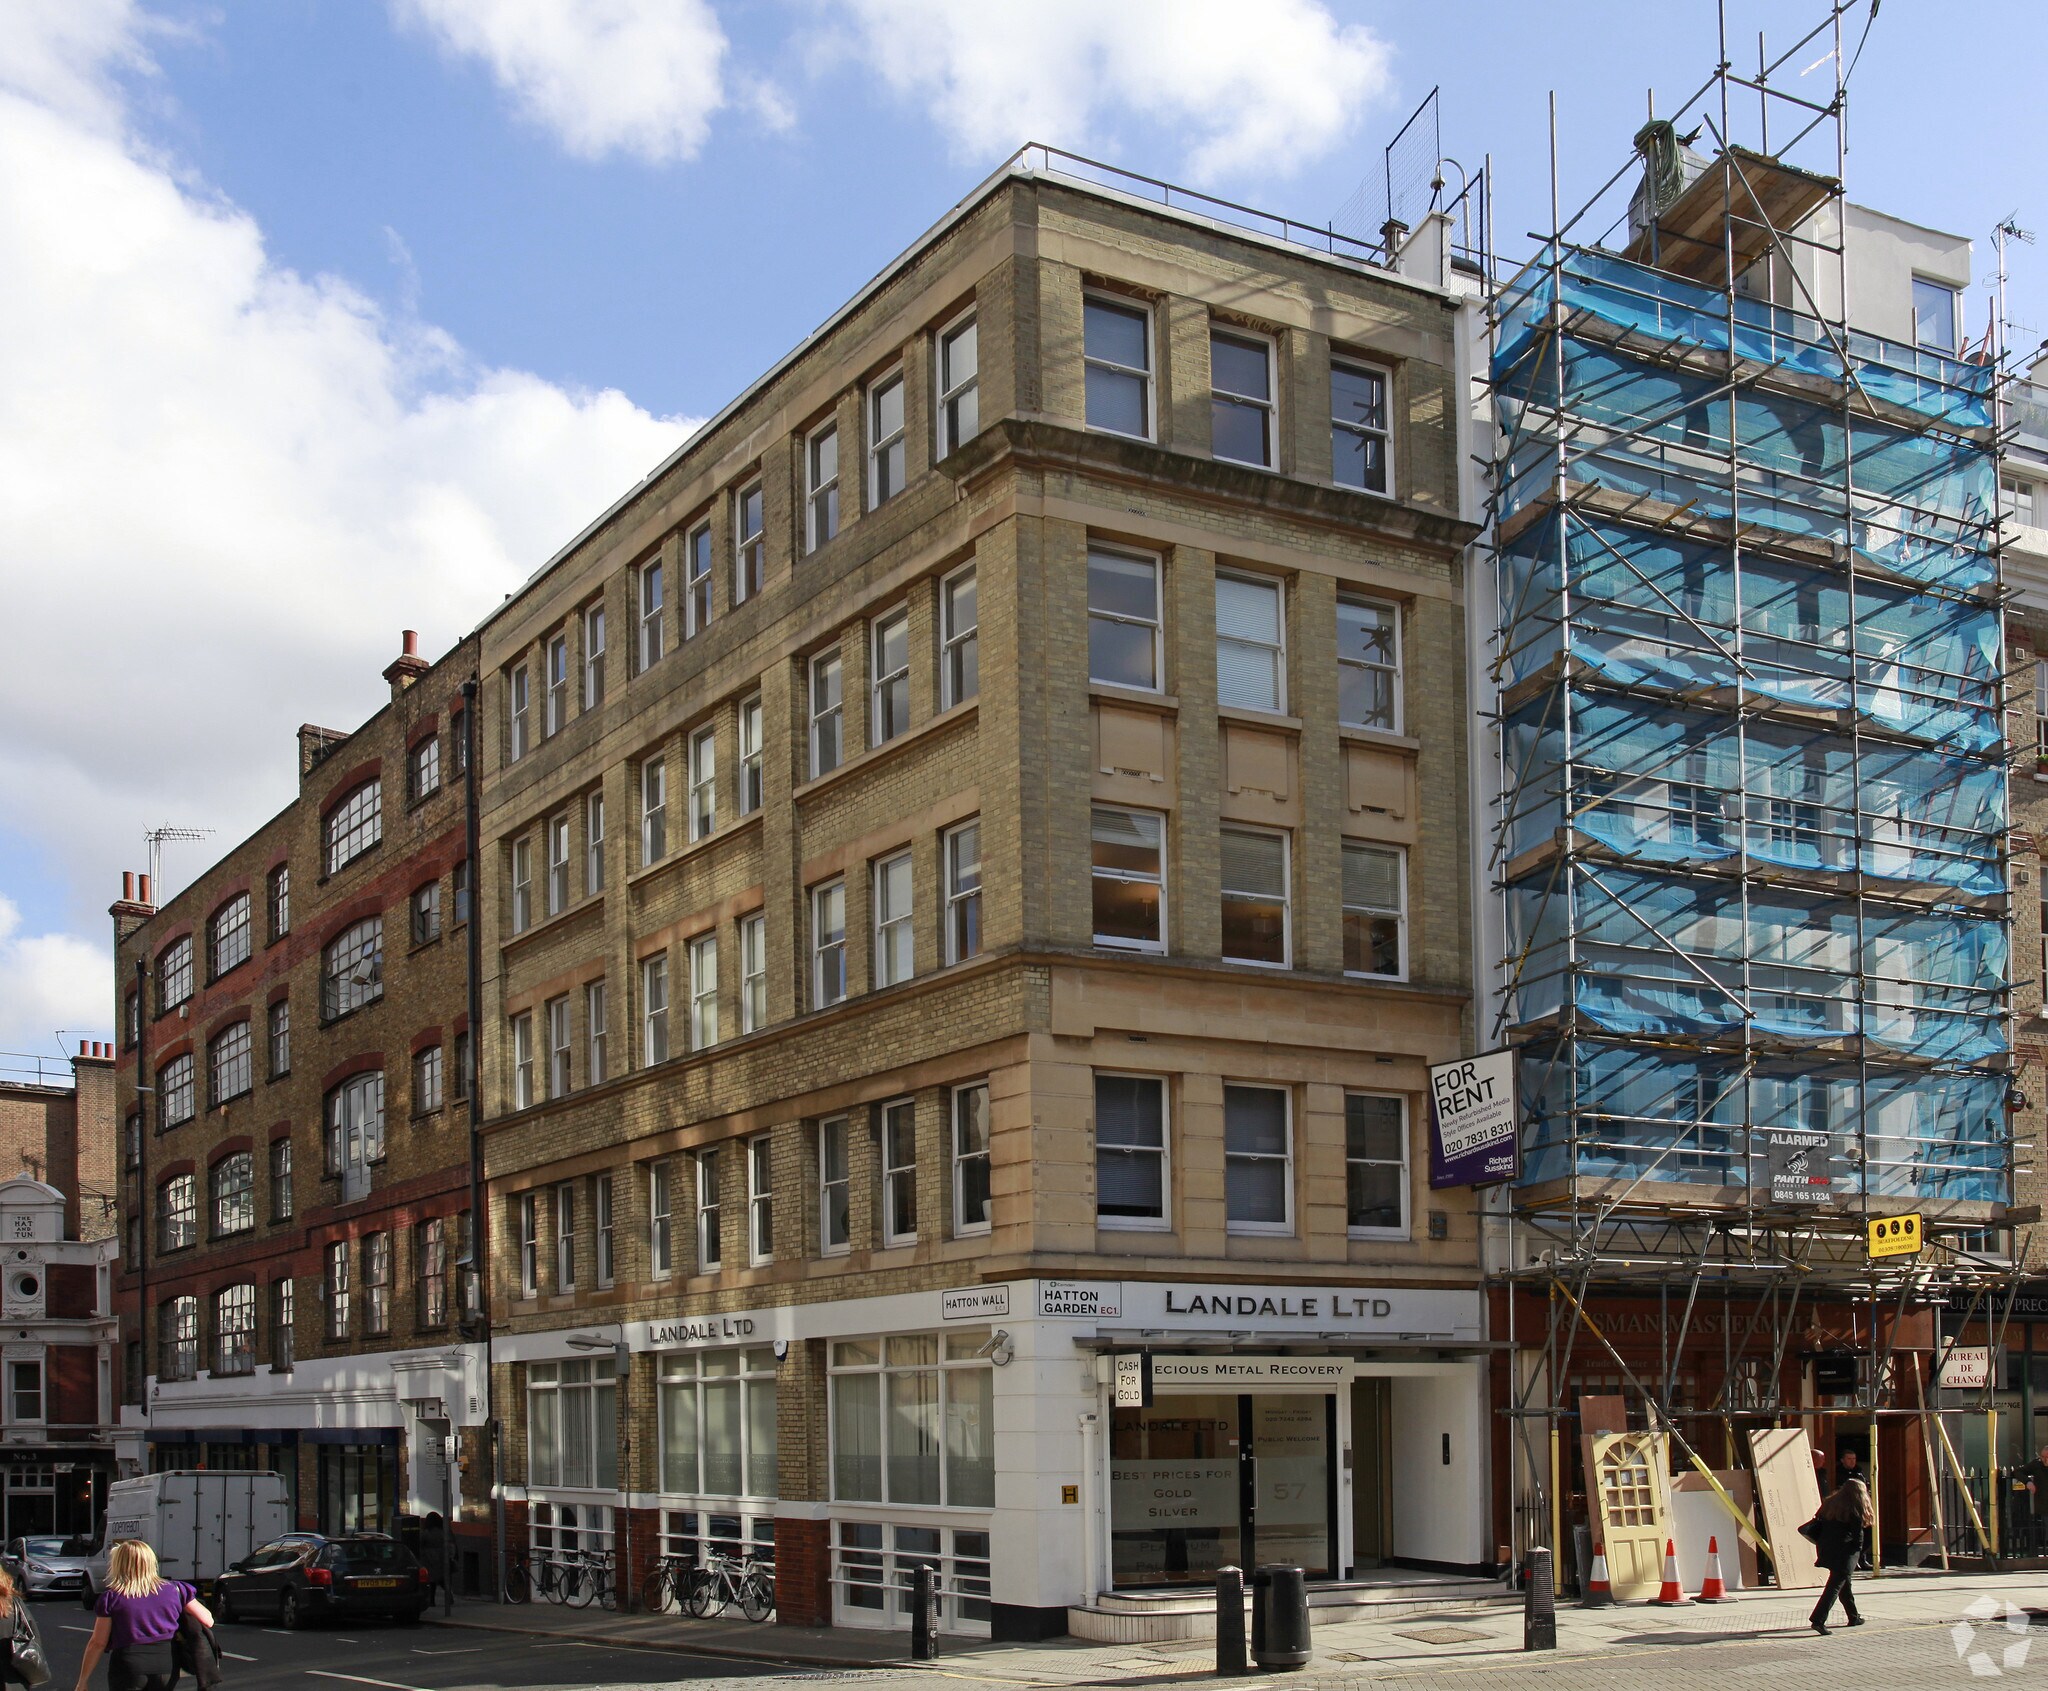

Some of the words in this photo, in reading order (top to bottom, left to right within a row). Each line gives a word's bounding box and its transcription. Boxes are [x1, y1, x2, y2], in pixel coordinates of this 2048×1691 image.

[1434, 1062, 1477, 1097] FOR
[1438, 1076, 1495, 1119] RENT
[1442, 1120, 1458, 1130] Newly
[1459, 1105, 1492, 1122] Refurbished
[1493, 1096, 1511, 1108] Media
[1443, 1128, 1456, 1139] Style
[1457, 1121, 1475, 1132] Offices
[1476, 1110, 1502, 1124] Available
[1445, 1139, 1463, 1155] 020
[1465, 1129, 1488, 1147] 7831
[1491, 1120, 1513, 1137] 8311
[1769, 1133, 1829, 1147] ALARMED
[1444, 1134, 1513, 1164] www.richardsusskind.com
[1488, 1154, 1514, 1166] Richard
[1484, 1162, 1514, 1173] Susskind
[1774, 1190, 1794, 1200] 0845
[1795, 1191, 1810, 1200] 165
[1811, 1192, 1830, 1201] 1234
[945, 1297, 979, 1310] HATTON
[981, 1294, 1005, 1306] WALL
[1044, 1290, 1099, 1302] HATTON
[1044, 1303, 1098, 1314] GARDEN
[1165, 1290, 1318, 1317] LANDALE
[1332, 1295, 1391, 1318] LTD
[1667, 1313, 1813, 1335] MASTERMEL
[649, 1322, 717, 1343] LANDALE
[723, 1318, 754, 1338] LTD
[1947, 1351, 1987, 1361] BUREAU
[1117, 1360, 1140, 1371] CASH
[1152, 1364, 1209, 1375] ECIOUS
[1215, 1364, 1264, 1375] METAL
[1269, 1364, 1344, 1375] RECOVERY
[1584, 1359, 1612, 1368] Trade
[1960, 1364, 1974, 1372] DE
[1120, 1375, 1137, 1386] FOR
[1117, 1389, 1140, 1401] GOLD
[1112, 1420, 1191, 1432] LANDALE
[1197, 1420, 1229, 1432] LTD
[13, 1452, 37, 1461] No.3
[1112, 1470, 1147, 1481] BEST
[1153, 1470, 1201, 1480] PRICES
[1206, 1470, 1232, 1479] FOR
[1153, 1488, 1192, 1498] GOLD
[1273, 1482, 1307, 1500] 57
[1148, 1507, 1198, 1517] SILVER
[112, 1519, 140, 1535] openreach
[1140, 1541, 1211, 1552] PLAUM
[1136, 1560, 1216, 1572] PALIUM
